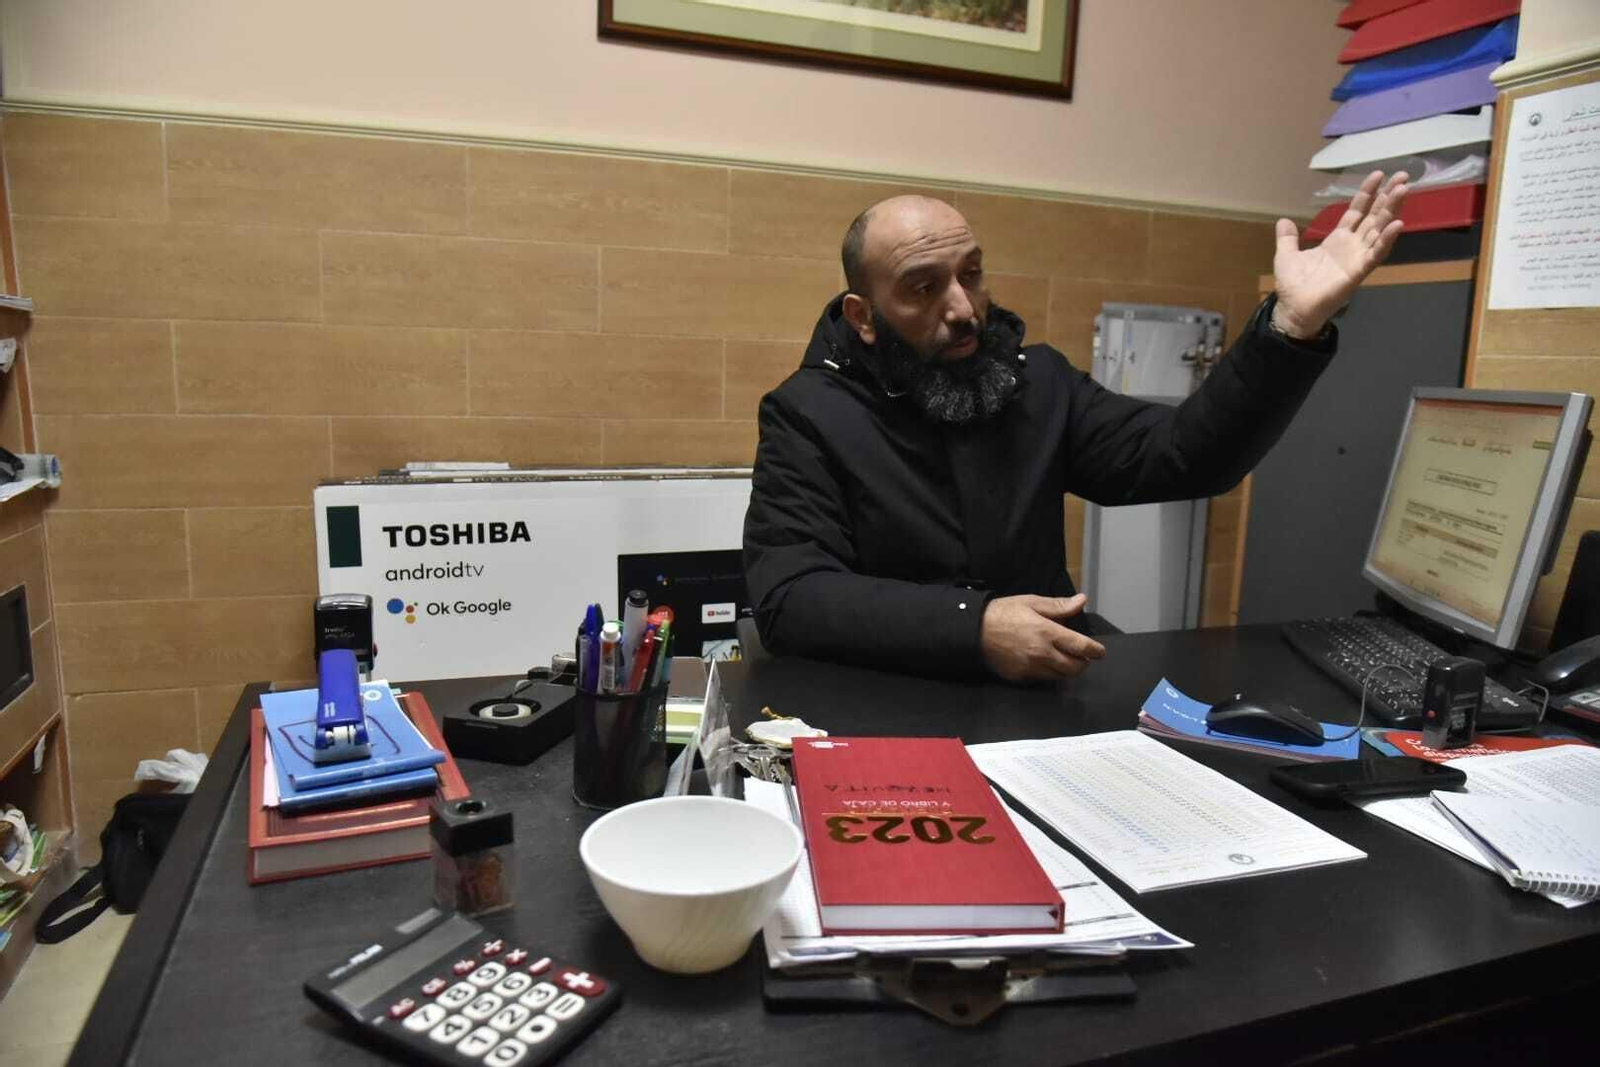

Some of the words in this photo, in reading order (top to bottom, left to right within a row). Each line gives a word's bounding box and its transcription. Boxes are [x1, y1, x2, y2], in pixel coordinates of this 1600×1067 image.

[382, 521, 531, 548] TOSHIBA
[426, 602, 450, 616] Ok
[453, 599, 512, 616] Google
[842, 799, 878, 808] CAJA
[825, 815, 997, 845] 2023
[412, 1010, 430, 1023] 7
[447, 989, 469, 1001] 8
[476, 967, 497, 980] 9
[444, 1022, 463, 1036] 4
[472, 999, 495, 1012] 5
[502, 976, 524, 990] 6
[470, 1034, 488, 1044] 1
[498, 1010, 523, 1024] 2
[527, 987, 550, 1001] 3
[494, 1045, 518, 1061] 0
